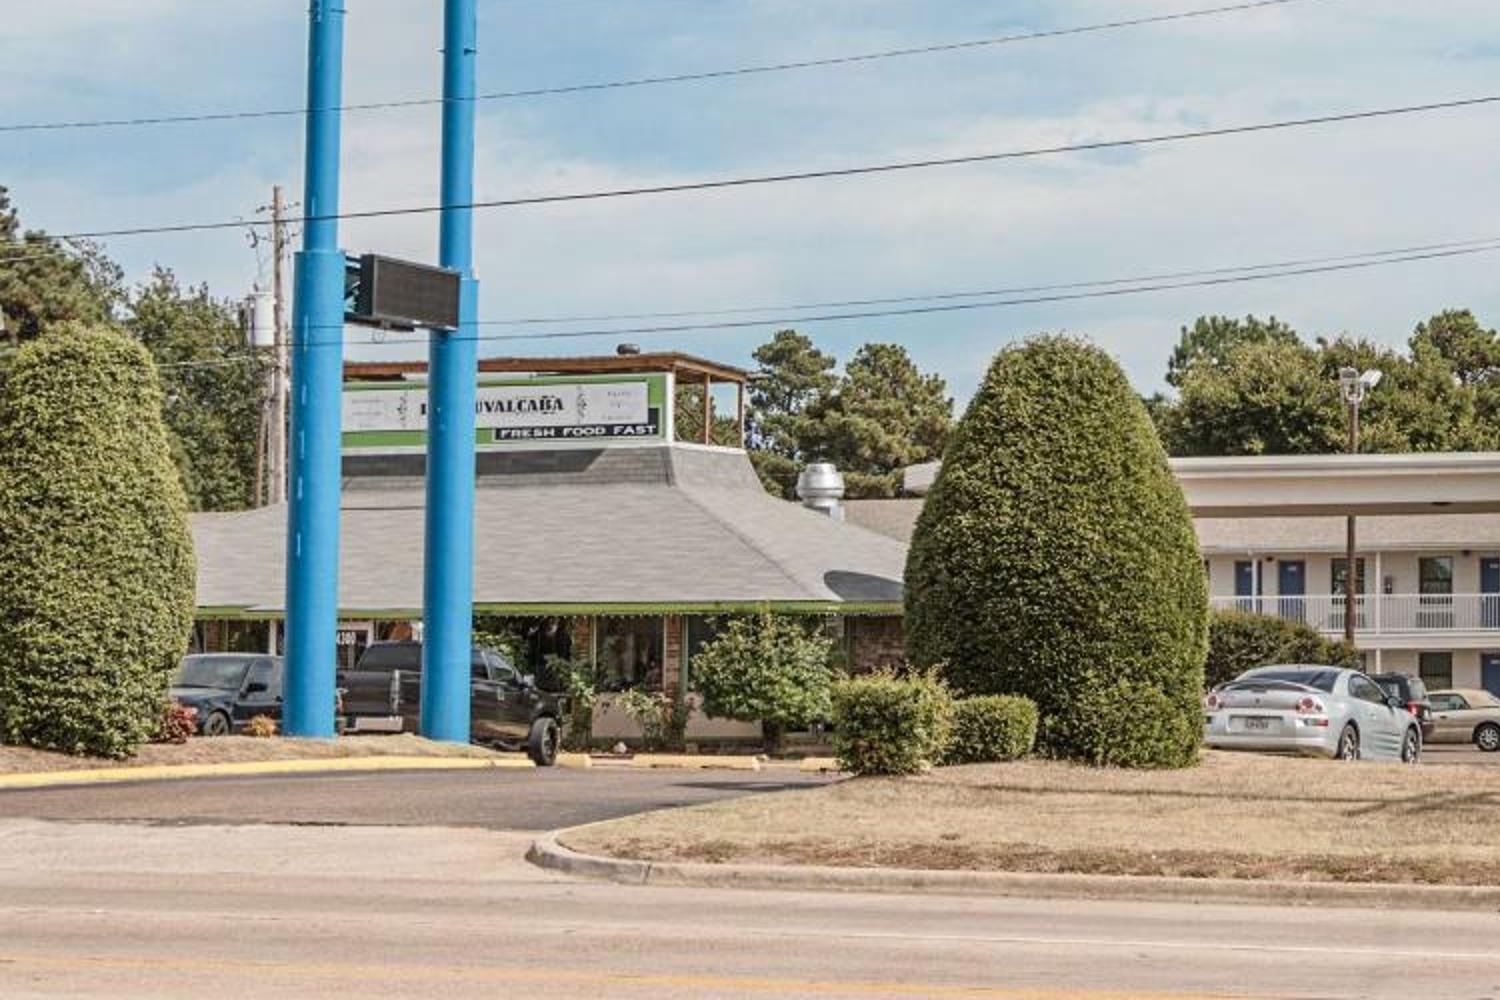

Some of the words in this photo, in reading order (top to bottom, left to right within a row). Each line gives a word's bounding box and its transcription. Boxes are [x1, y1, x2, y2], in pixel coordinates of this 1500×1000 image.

[475, 395, 564, 416] UVALCABA
[500, 428, 556, 438] FRESH
[563, 426, 606, 436] FOOD
[613, 425, 656, 435] FAST
